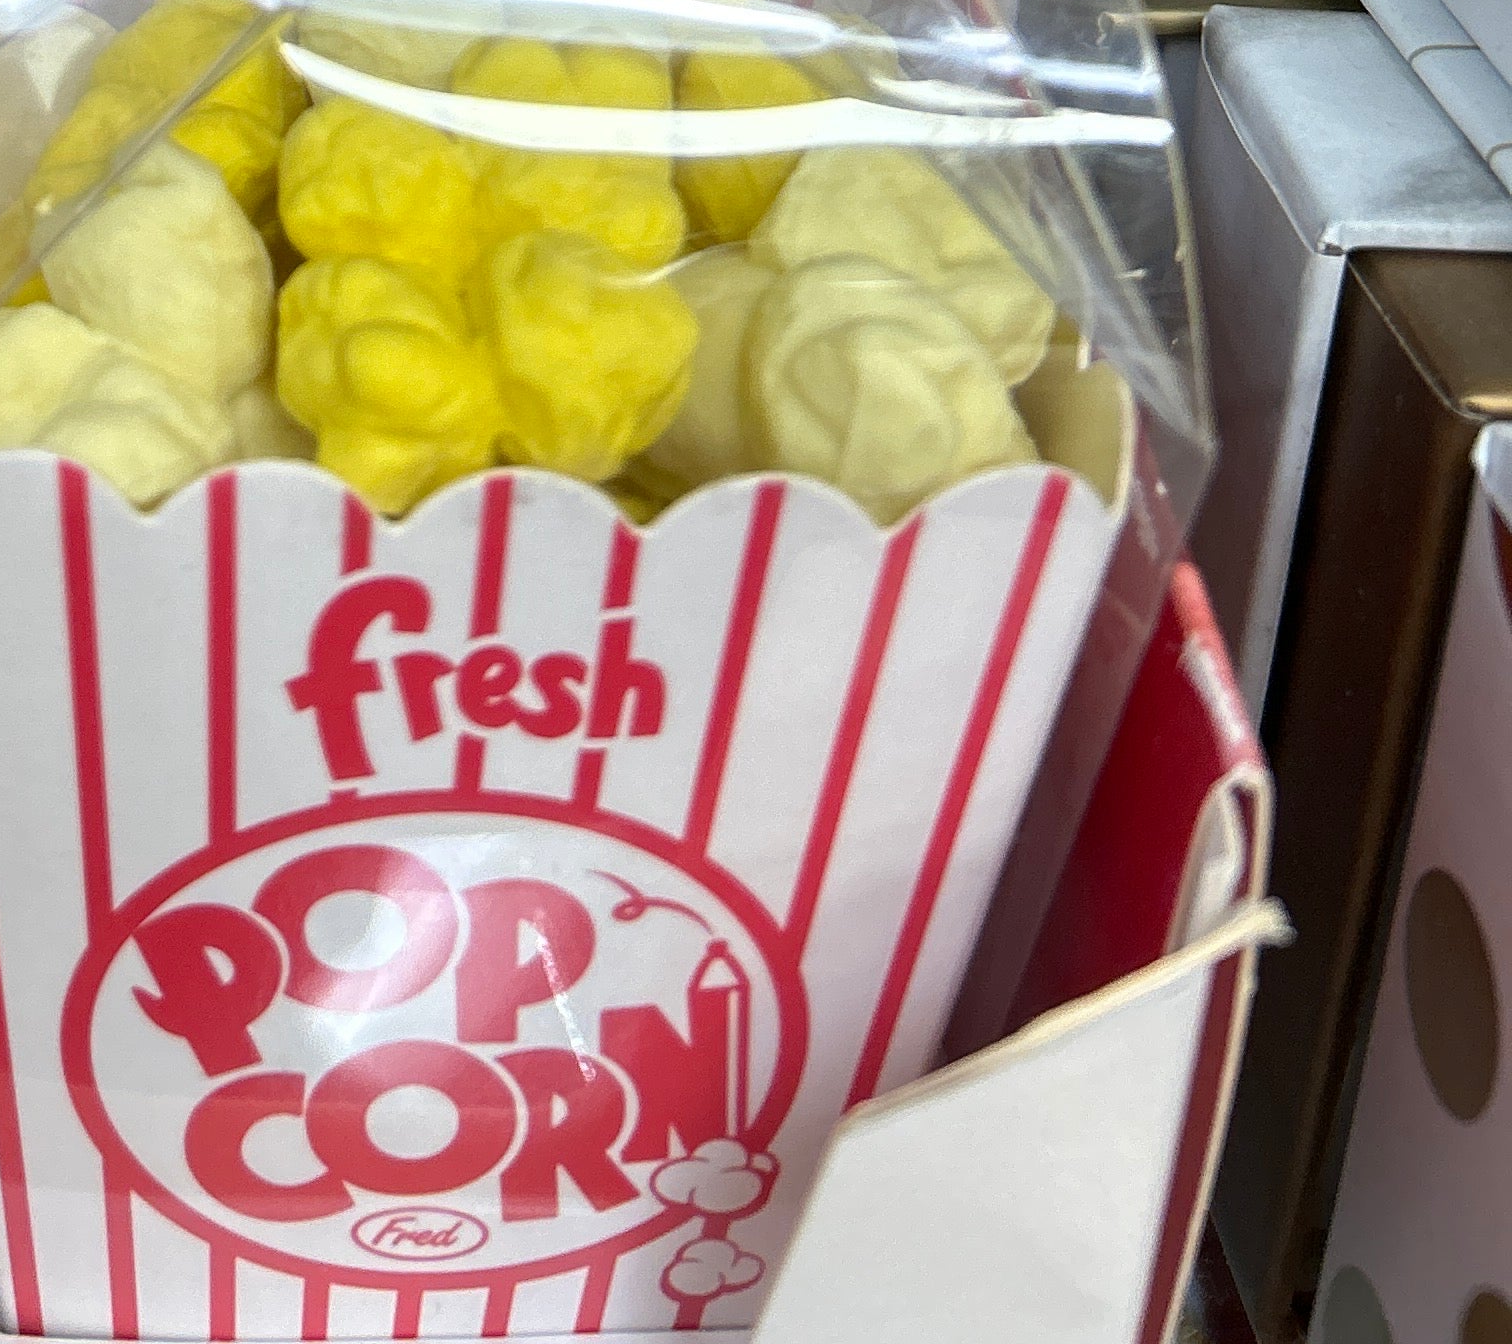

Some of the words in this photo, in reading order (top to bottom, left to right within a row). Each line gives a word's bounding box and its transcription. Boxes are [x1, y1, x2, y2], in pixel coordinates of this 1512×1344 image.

[285, 573, 667, 780] fresh
[131, 844, 596, 1077] POP
[184, 984, 744, 1221] CORN
[372, 1216, 466, 1249] Fred
